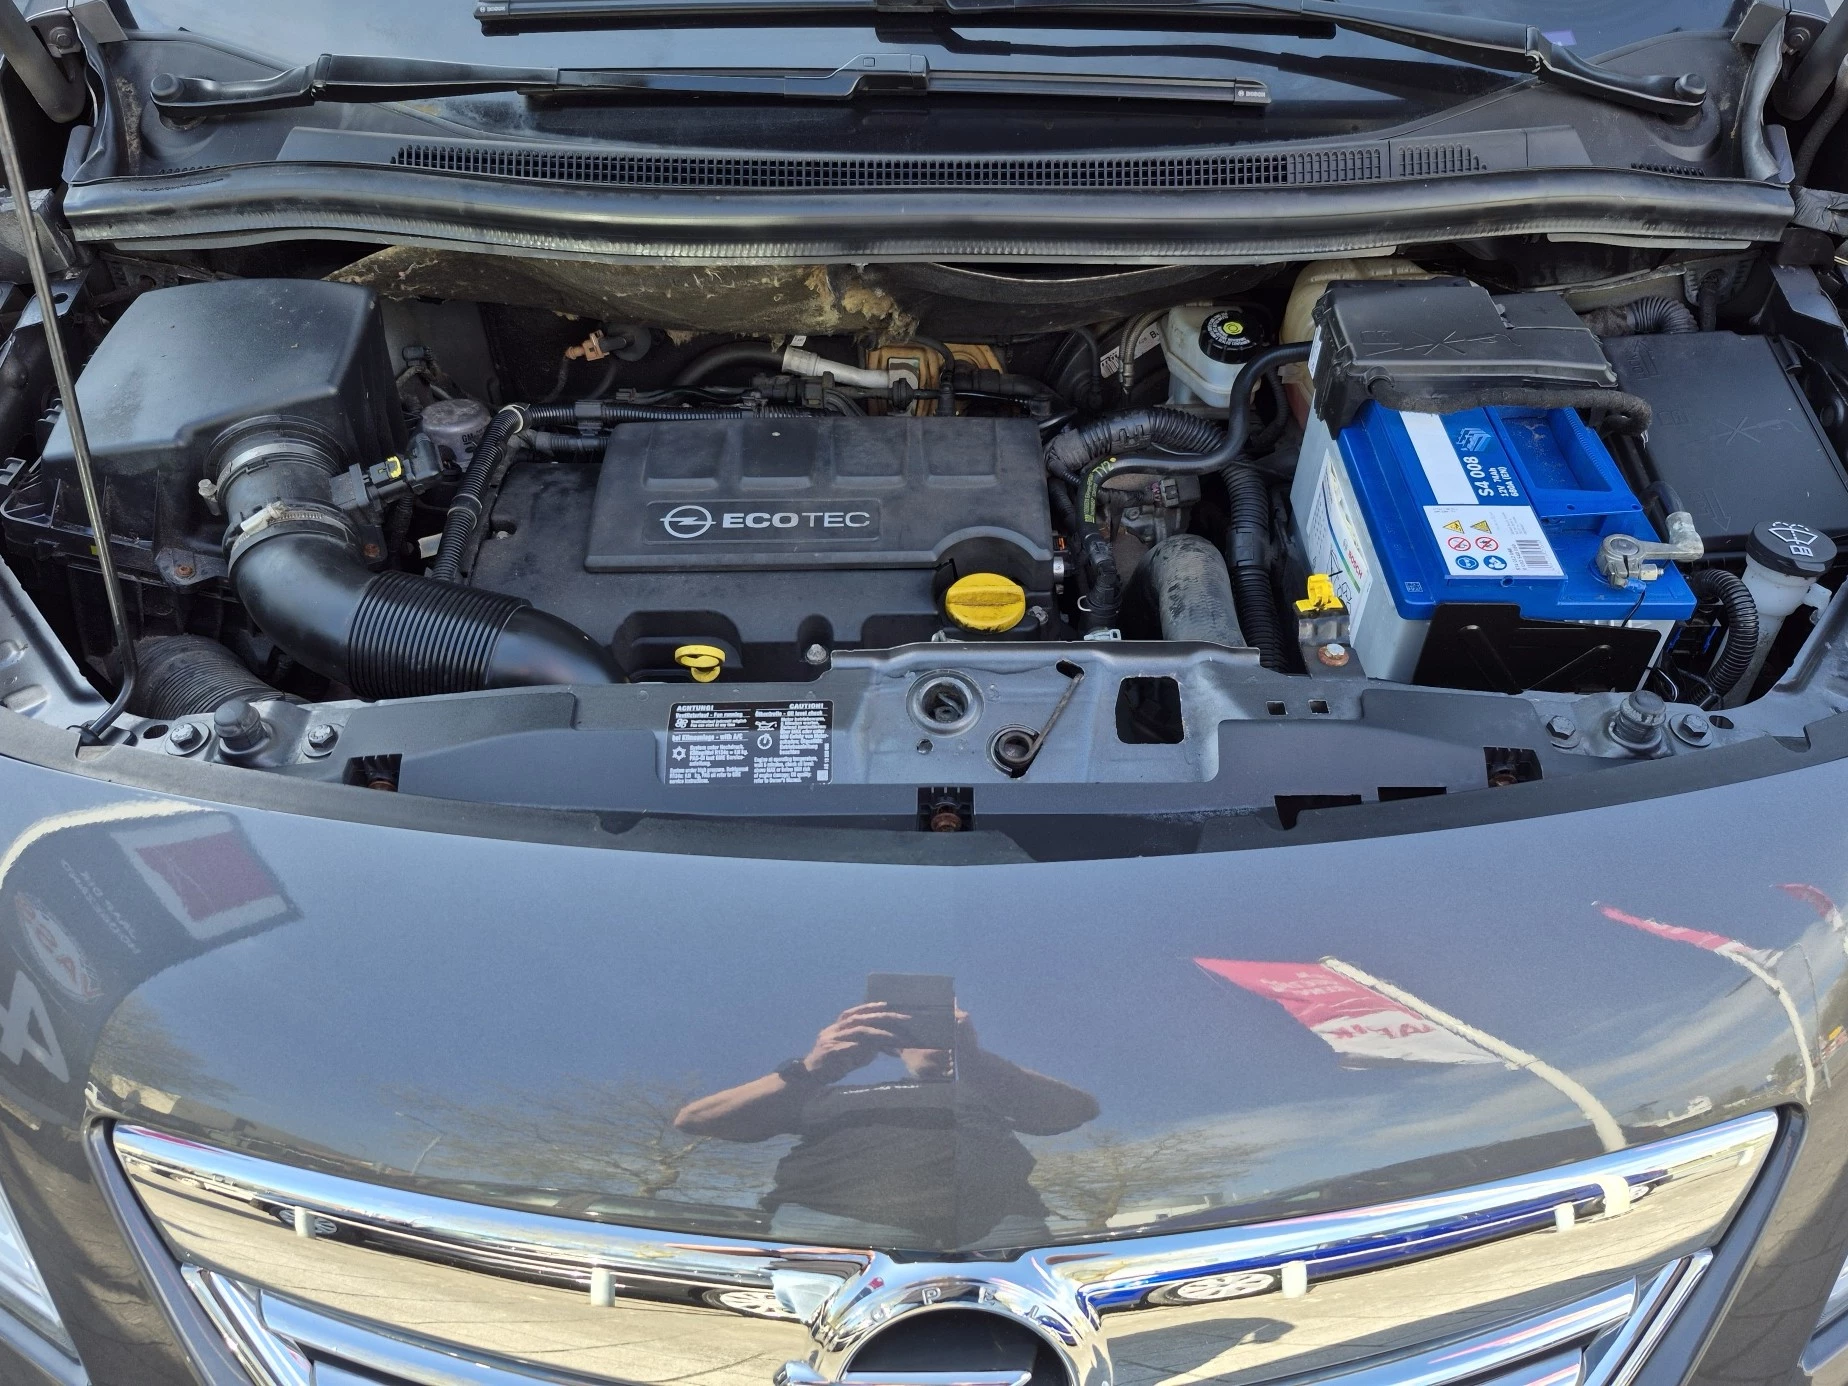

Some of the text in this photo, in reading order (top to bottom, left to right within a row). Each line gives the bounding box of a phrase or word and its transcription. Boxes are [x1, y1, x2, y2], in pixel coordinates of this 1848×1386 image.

[1463, 456, 1495, 497] S4 008
[1497, 485, 1509, 497] 12V
[722, 511, 871, 530] ECOTEC
[1347, 550, 1362, 579] BOSCH
[676, 704, 714, 712] ACHTUNG!
